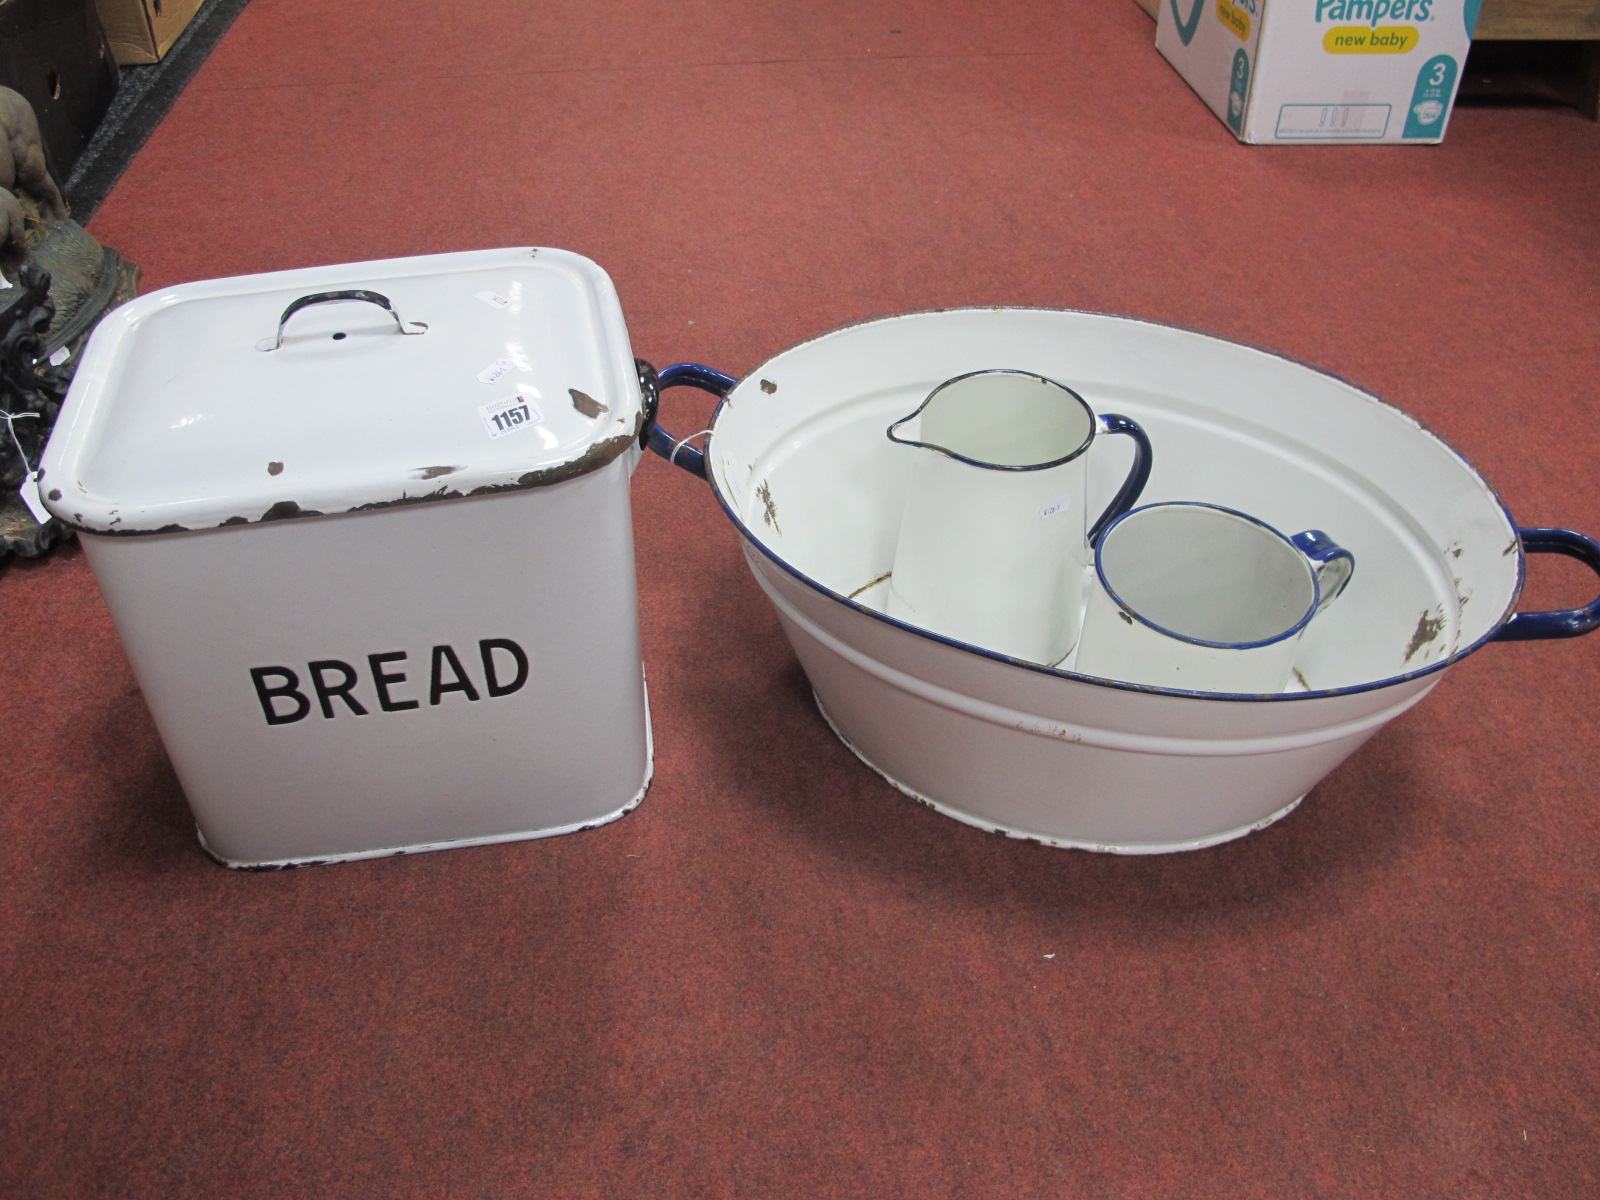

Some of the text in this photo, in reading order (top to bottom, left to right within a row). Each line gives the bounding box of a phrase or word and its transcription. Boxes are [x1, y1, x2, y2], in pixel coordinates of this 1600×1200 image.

[1335, 32, 1408, 50] new baby
[1236, 57, 1244, 79] 3
[1429, 63, 1446, 86] 3
[491, 404, 531, 431] 1157
[249, 638, 529, 726] BREAD
